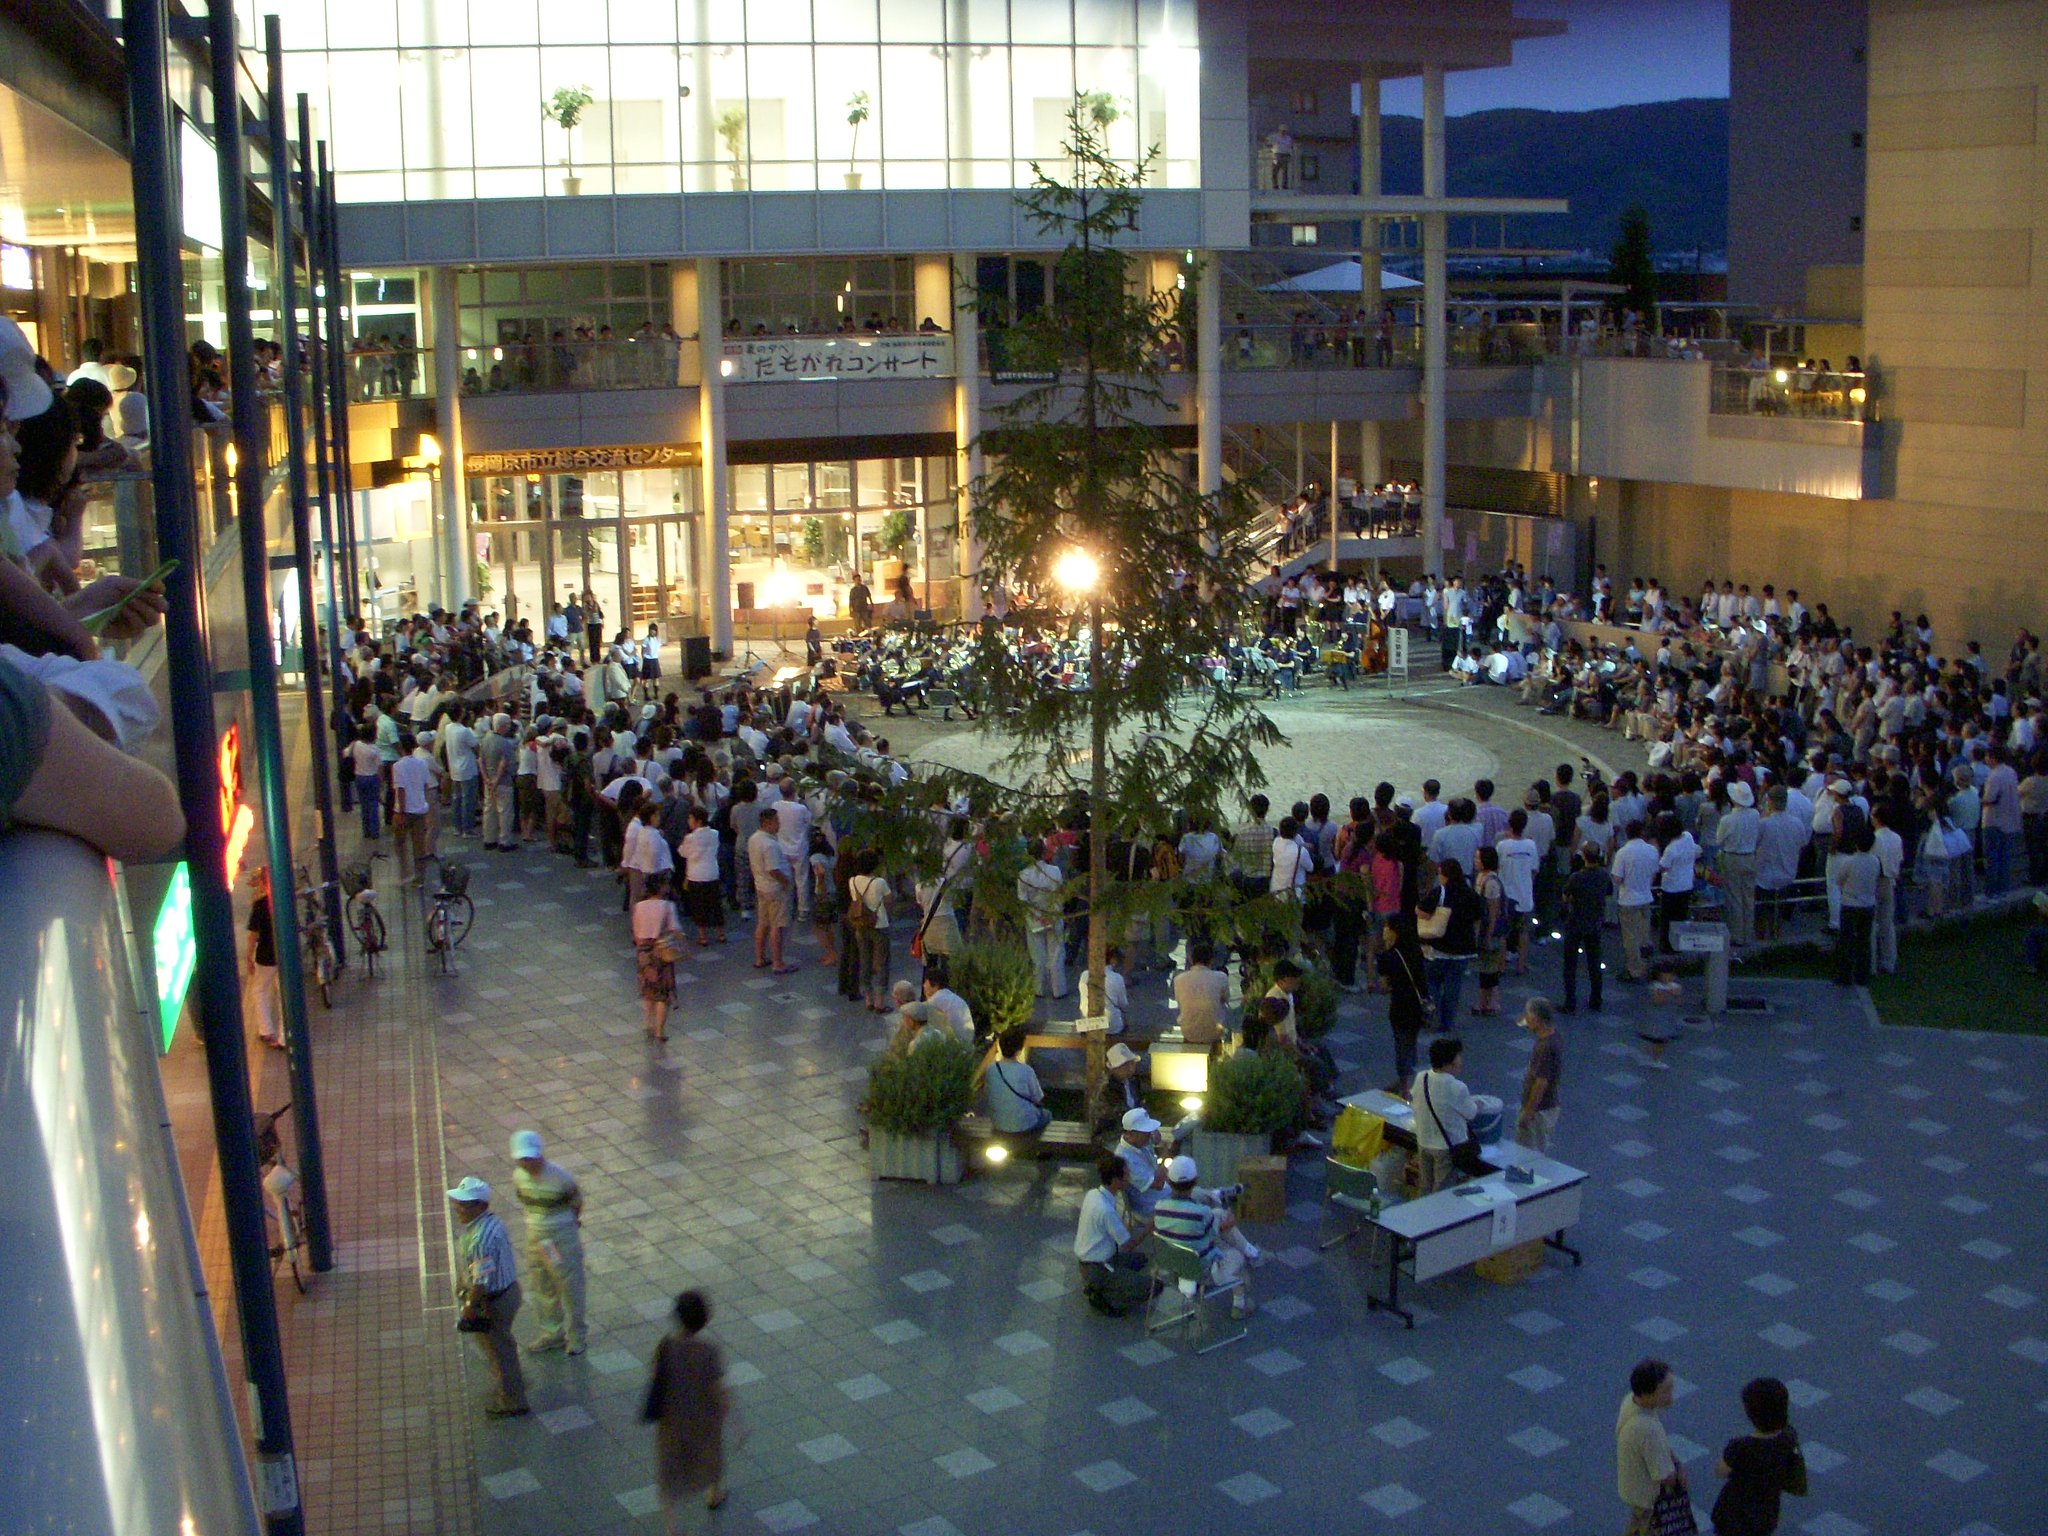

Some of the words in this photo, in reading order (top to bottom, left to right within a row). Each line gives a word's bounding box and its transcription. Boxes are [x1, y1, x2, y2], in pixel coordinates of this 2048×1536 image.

[754, 351, 937, 378] たそがれコンサート
[466, 446, 693, 472] 長岡京市立総合交流センター
